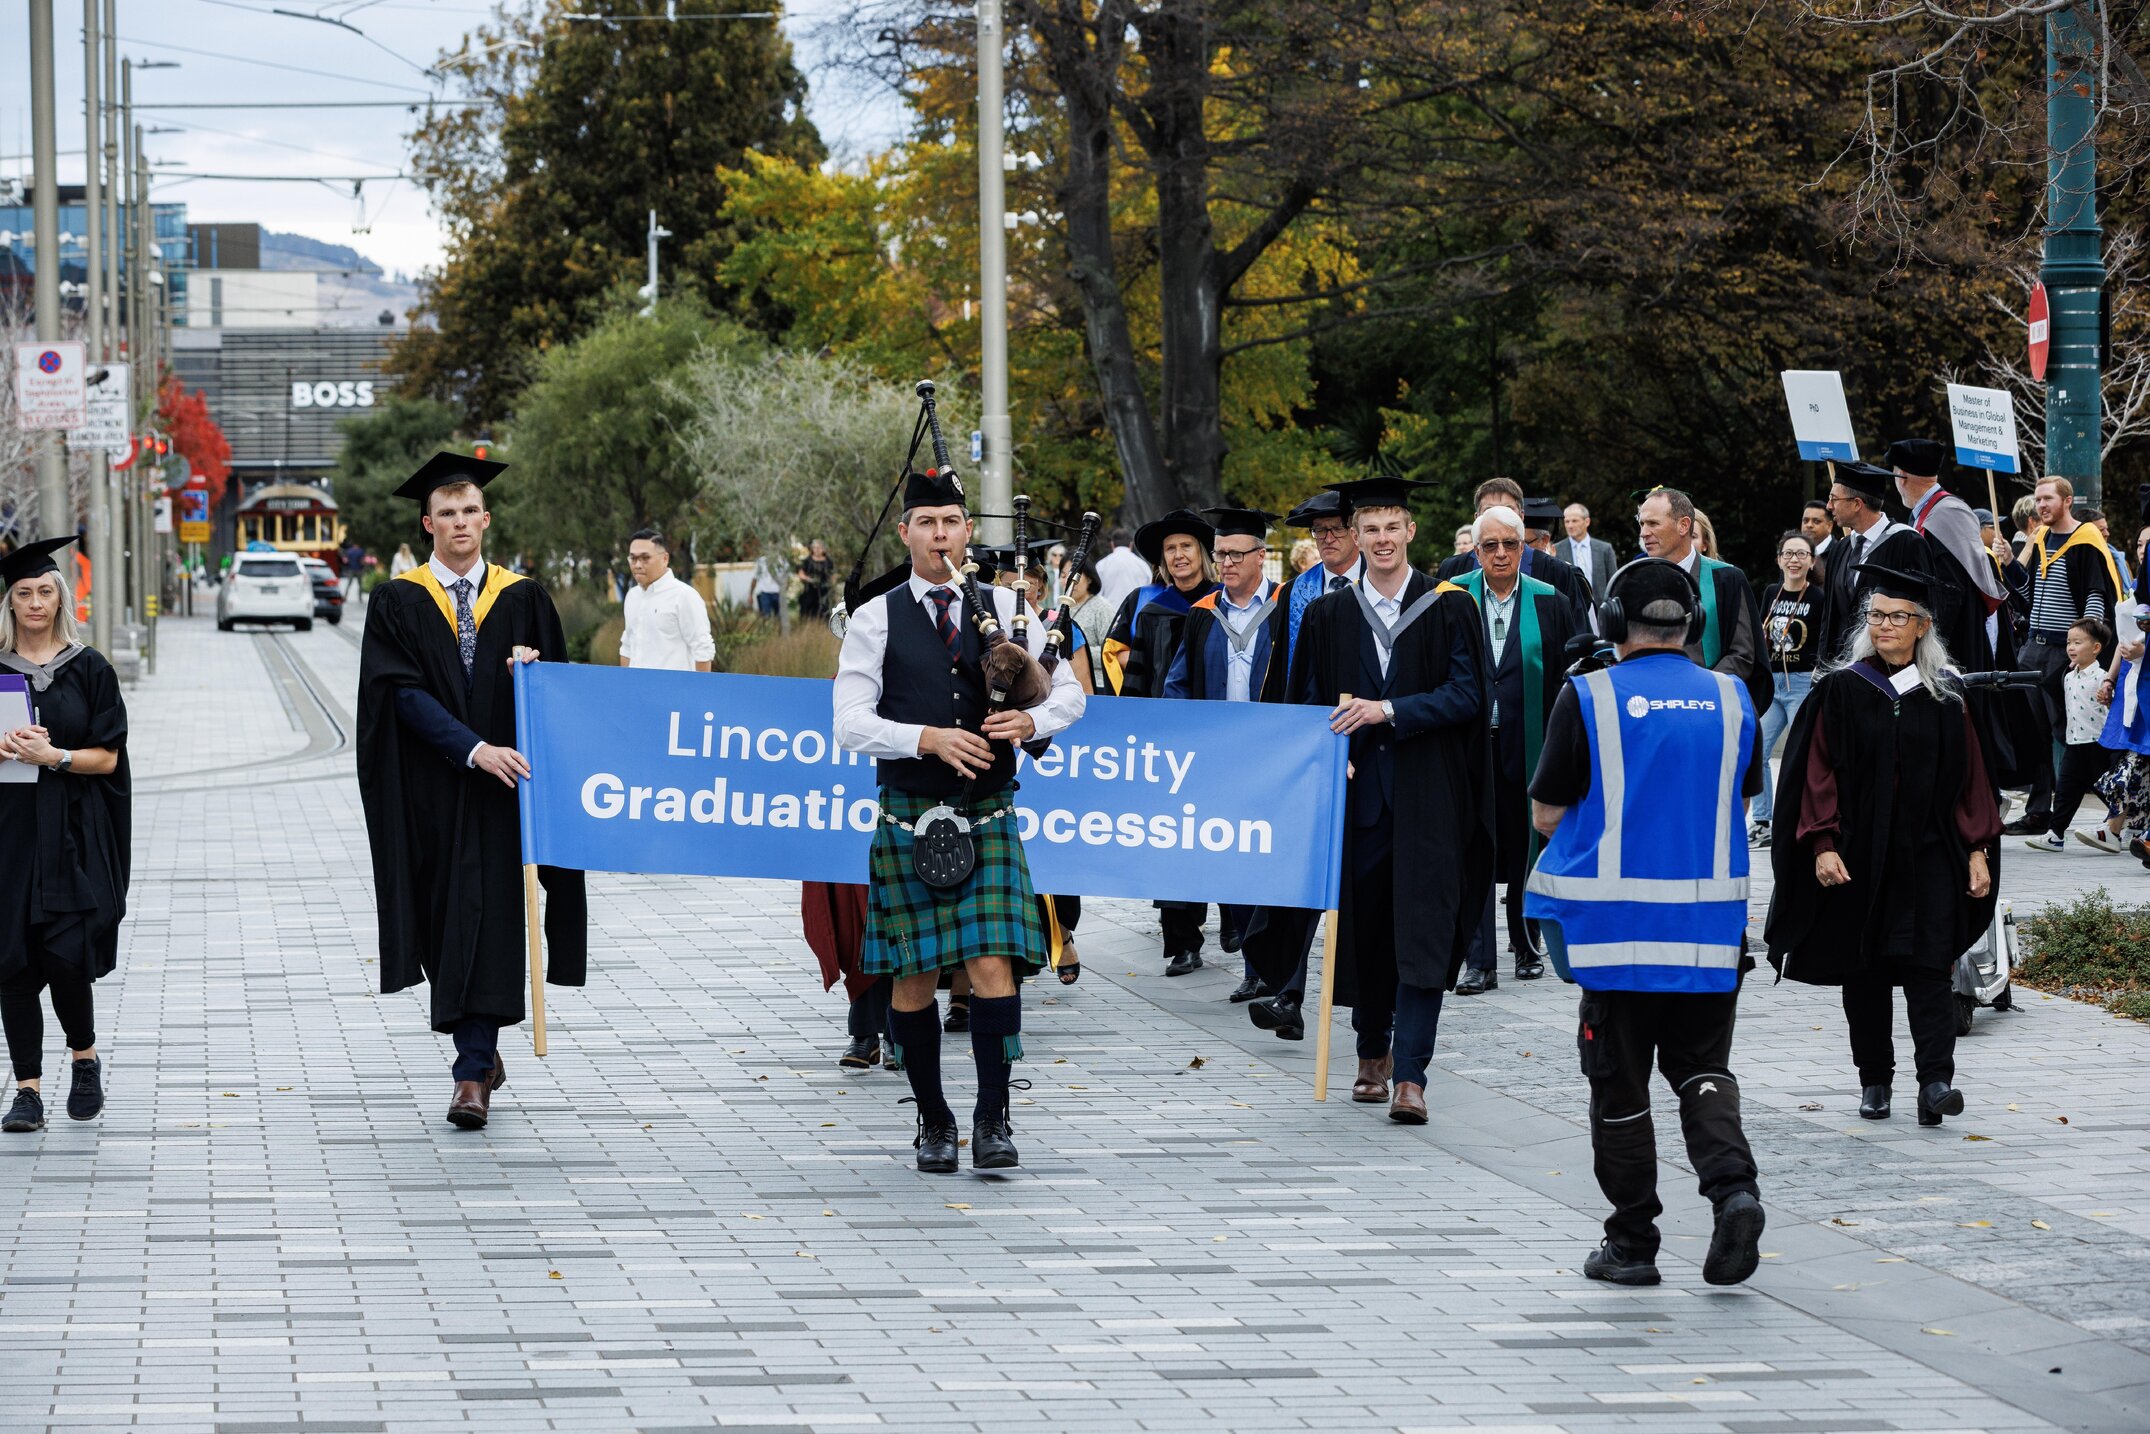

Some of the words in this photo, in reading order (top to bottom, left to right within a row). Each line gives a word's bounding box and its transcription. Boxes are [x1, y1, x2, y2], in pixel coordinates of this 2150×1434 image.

[292, 381, 375, 408] BOSS
[1963, 394, 1983, 406] Master
[1985, 397, 1991, 407] of
[1809, 403, 1819, 412] PhD
[1952, 405, 1978, 418] Business
[1979, 410, 1985, 420] in
[1986, 411, 2006, 423] Global
[1959, 419, 1997, 434] Management
[1999, 426, 2003, 436] &
[1967, 434, 1998, 450] Marketing
[1650, 700, 1715, 711] SHIPLEYS
[1016, 735, 1196, 794] ersity
[581, 772, 878, 832] Graduatio
[1014, 803, 1272, 854] ocession
